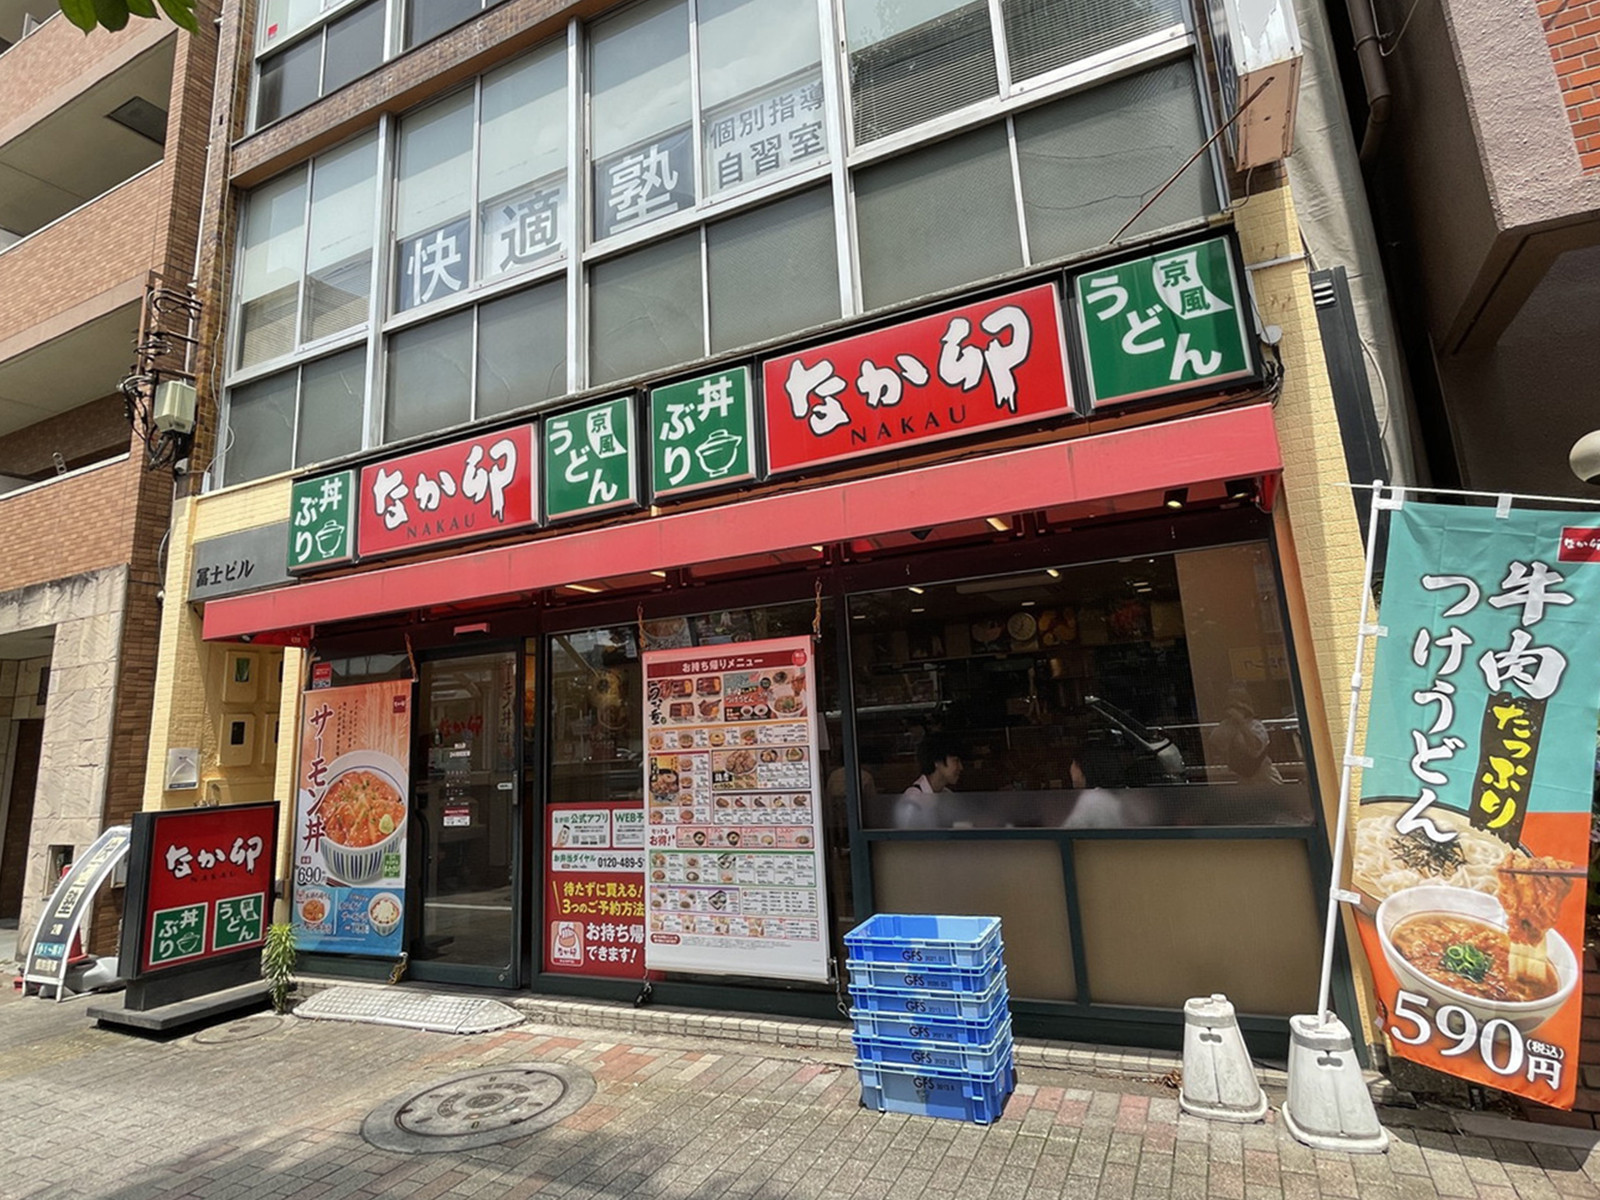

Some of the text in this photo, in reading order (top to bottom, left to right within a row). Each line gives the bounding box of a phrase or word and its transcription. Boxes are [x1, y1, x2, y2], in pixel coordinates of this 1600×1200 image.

[710, 81, 824, 149] 個別指導
[718, 121, 825, 189] 自習室
[1160, 258, 1210, 316] 京風
[1085, 274, 1222, 382] うどん
[785, 305, 1032, 436] なか卯
[591, 412, 615, 454] 京風
[851, 405, 967, 445] NAKAU
[549, 421, 618, 505] うどん
[373, 438, 517, 530] なか卯
[406, 514, 476, 539] NAKAU
[1479, 561, 1575, 700] 牛肉
[682, 657, 763, 672] お持ち帰りメニュー
[1395, 575, 1480, 843] つけうどん
[302, 703, 334, 853] サーモン丼
[1480, 704, 1531, 828] たっぷり
[165, 836, 263, 880] なか卯
[598, 856, 645, 868] 0120-489-5
[298, 866, 322, 884] 690
[563, 881, 643, 898] 待たずに買える!
[219, 903, 255, 942] うどん
[562, 900, 644, 917] 3つのご予約方法
[586, 922, 644, 944] お持ち帰
[587, 946, 637, 963] できます!
[902, 950, 923, 962] GFS
[904, 974, 925, 986] GFS
[905, 999, 927, 1013] GFS
[909, 1025, 930, 1038] GFS
[911, 1050, 933, 1064] GFS
[1526, 1038, 1564, 1060] (税込)
[913, 1076, 935, 1090] GFS
